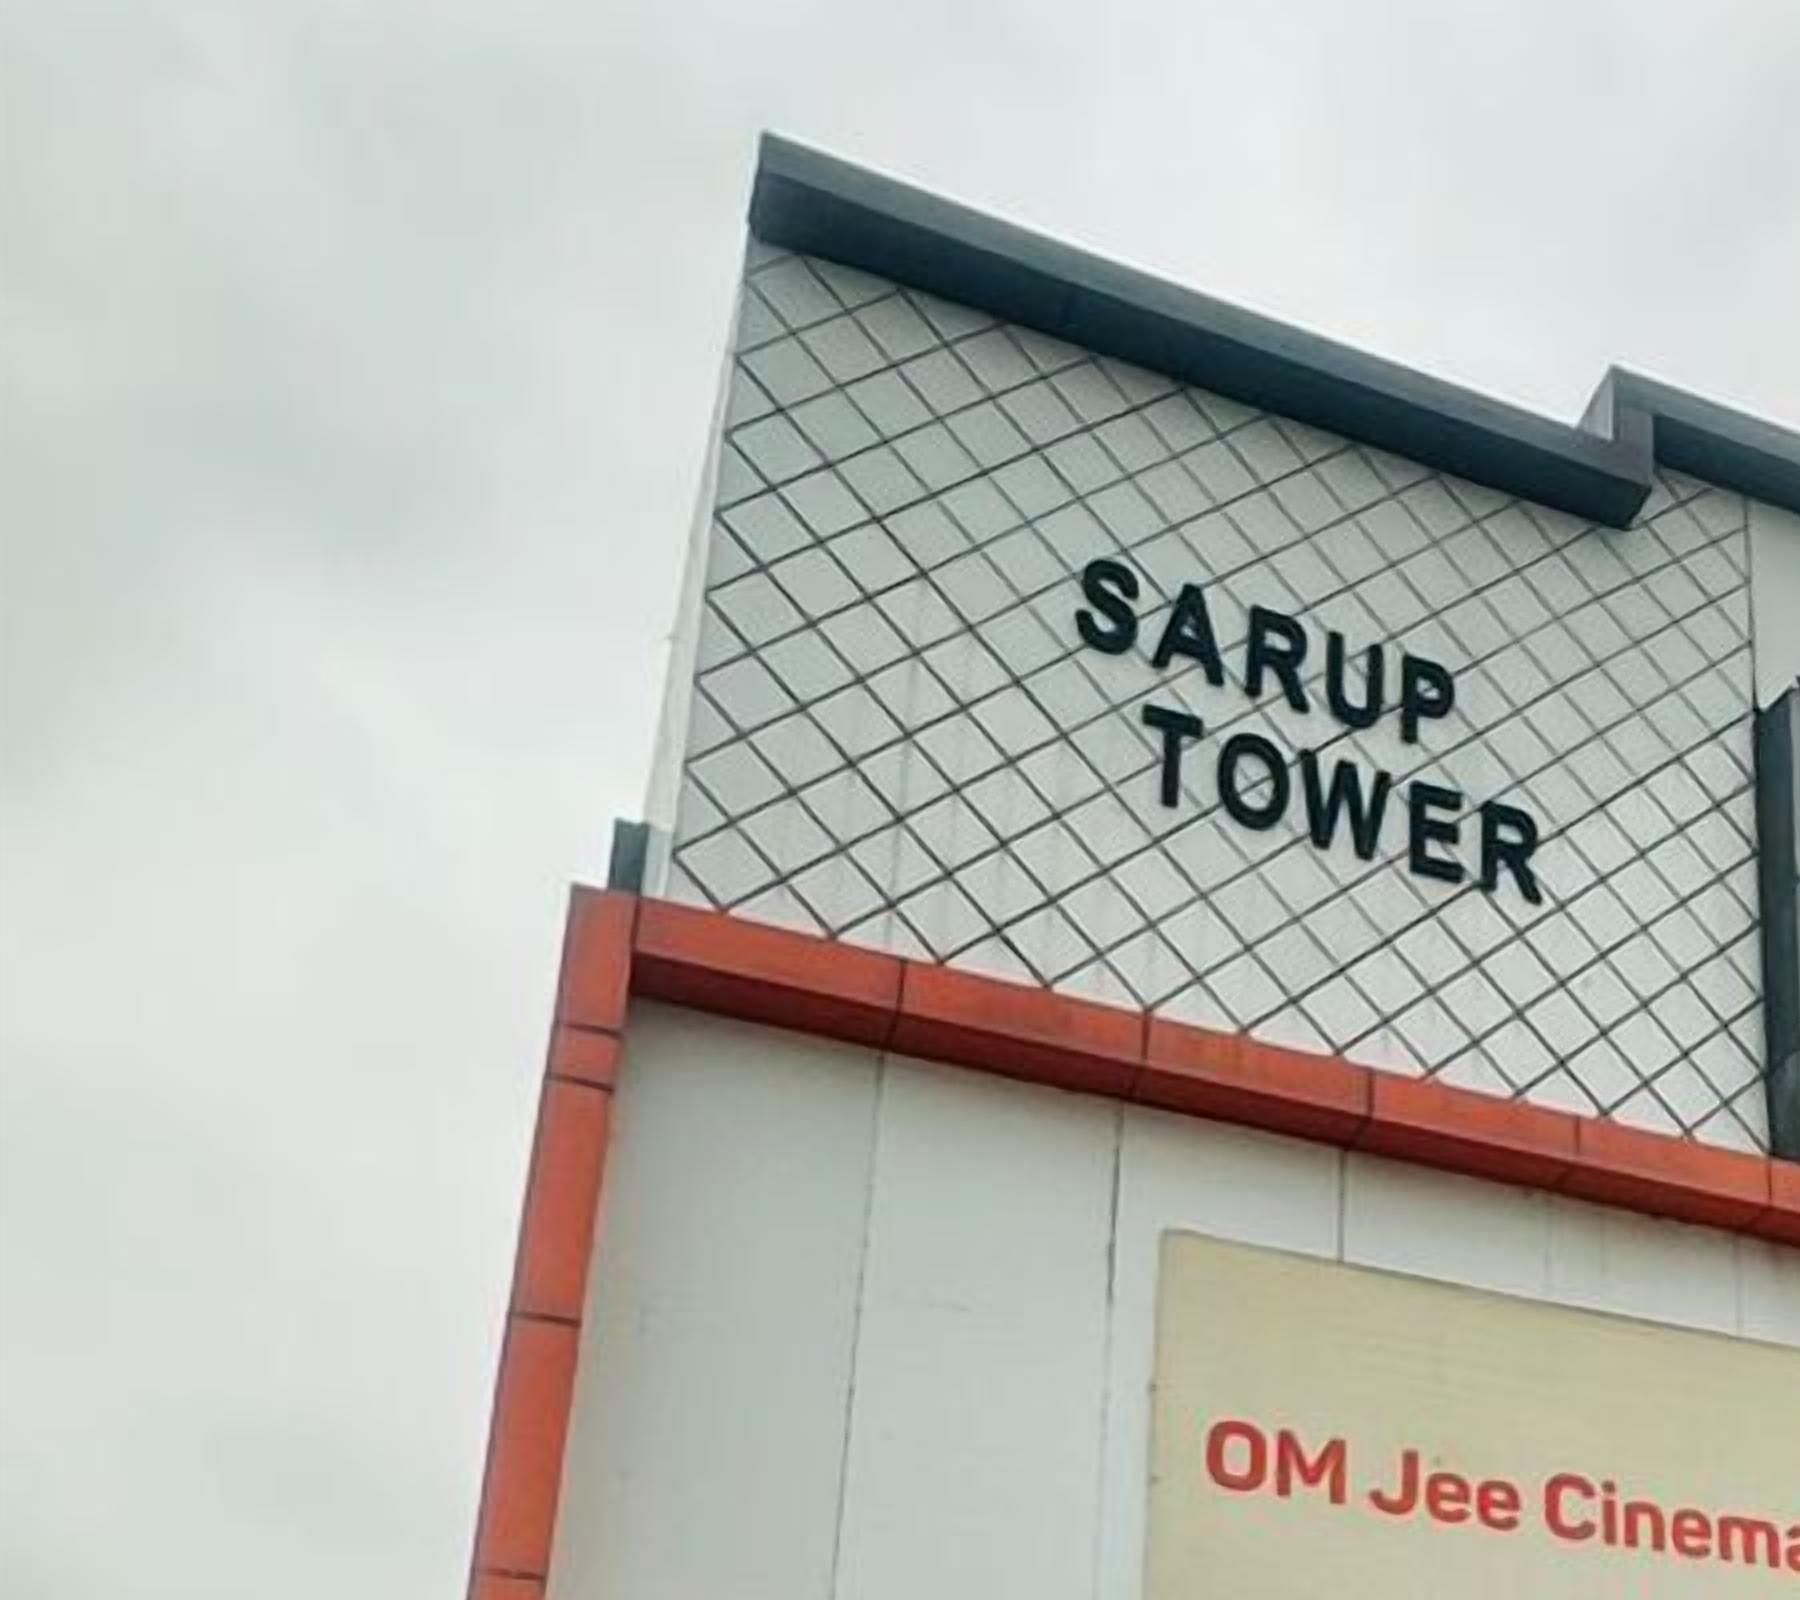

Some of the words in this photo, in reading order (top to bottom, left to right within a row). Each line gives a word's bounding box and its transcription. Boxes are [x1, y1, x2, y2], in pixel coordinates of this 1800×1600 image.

[1075, 559, 1455, 743] SARUP
[1142, 703, 1542, 903] TOWER
[1205, 1419, 1347, 1504] OM
[1369, 1448, 1521, 1531] Jee
